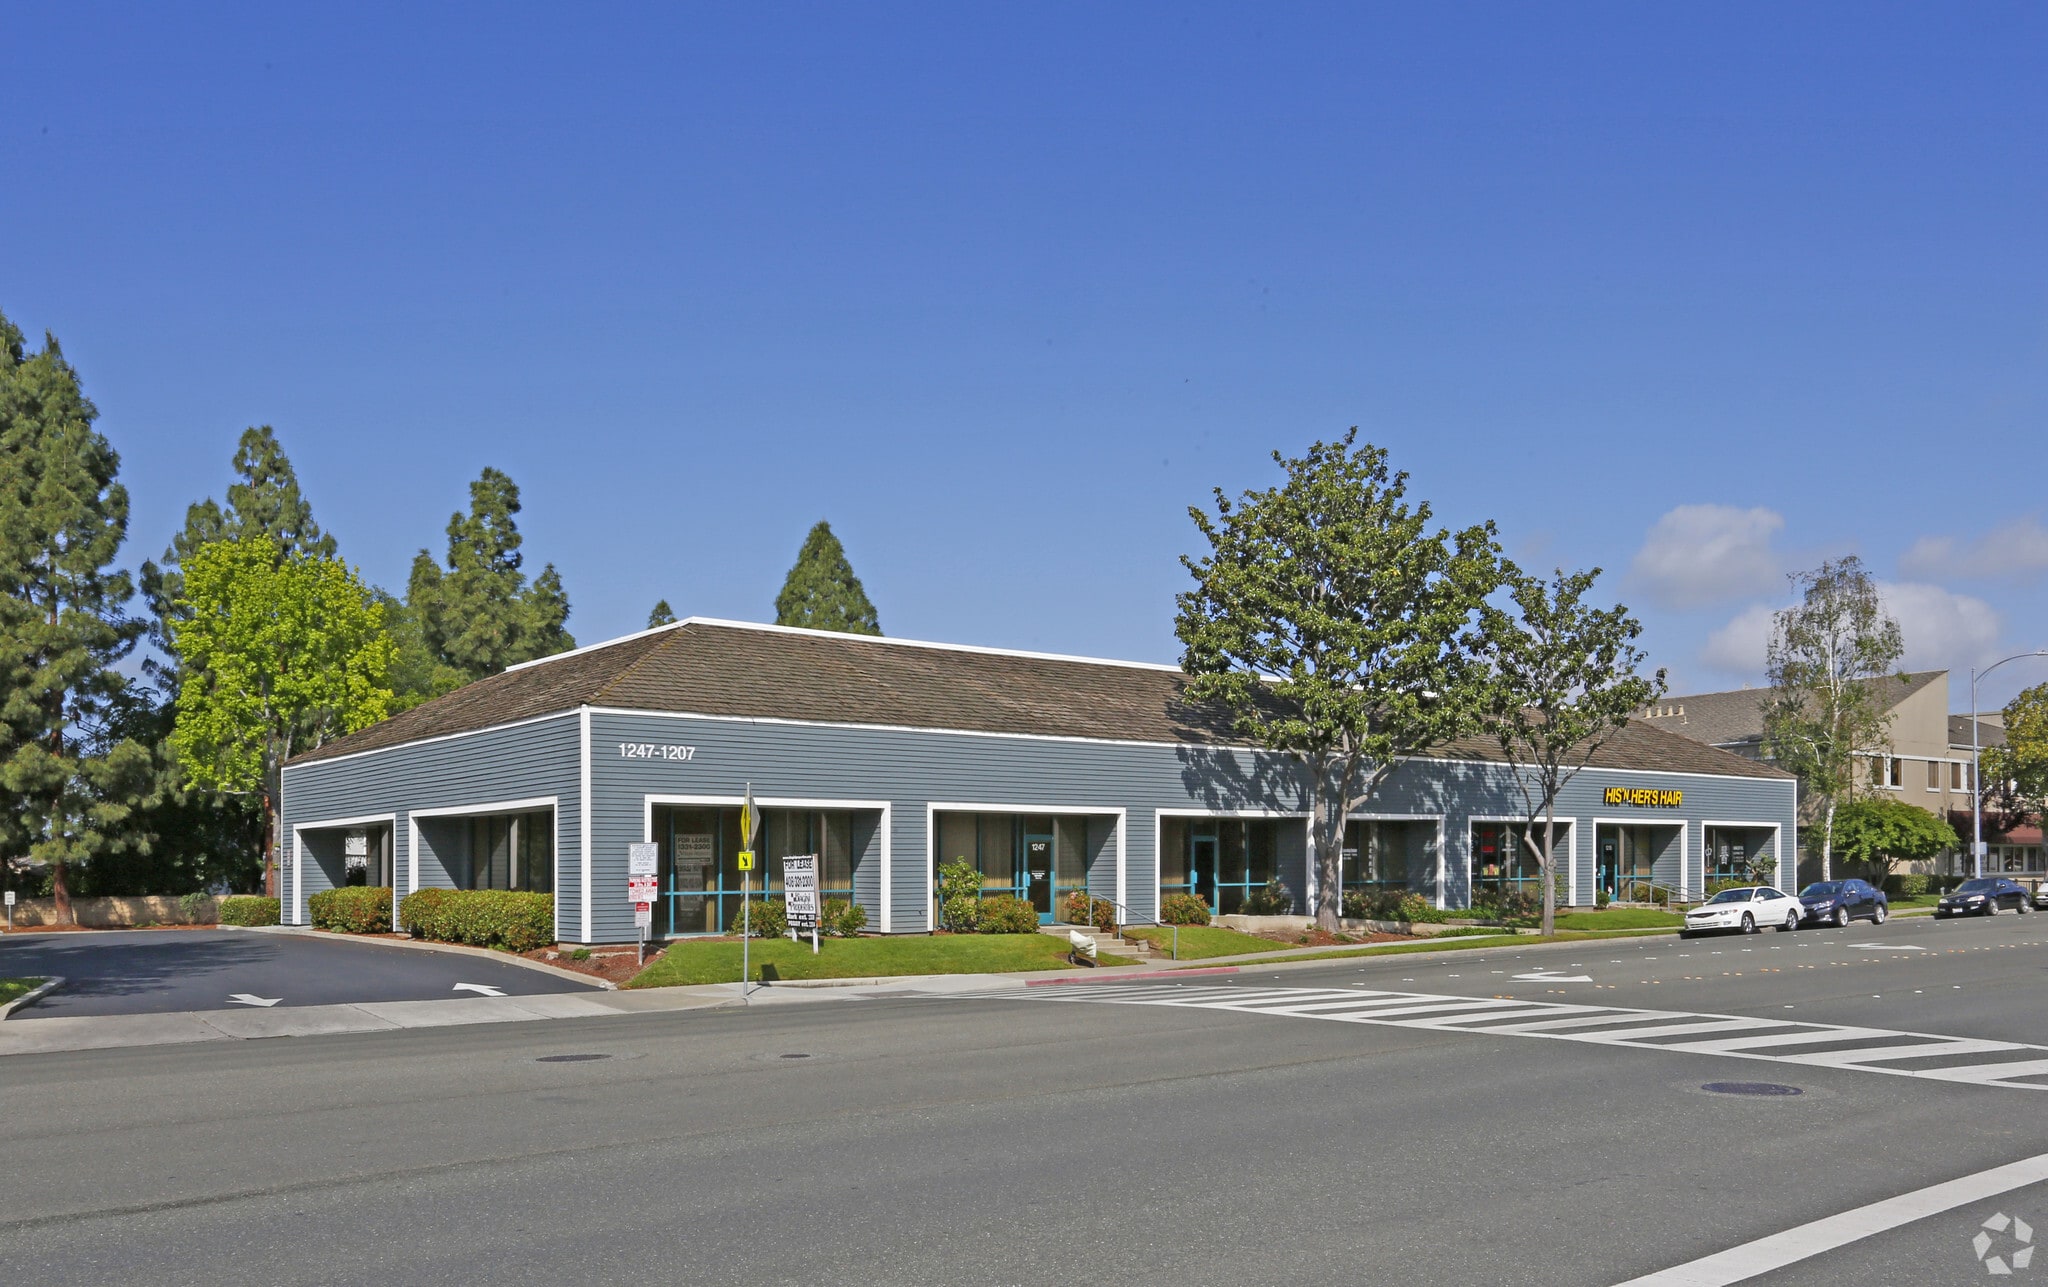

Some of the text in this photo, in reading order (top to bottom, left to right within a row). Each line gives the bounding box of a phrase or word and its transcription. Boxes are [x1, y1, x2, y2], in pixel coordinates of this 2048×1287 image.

[618, 743, 696, 761] 1247-1207
[1631, 789, 1659, 805] HER'S
[1660, 790, 1682, 806] HAIR
[785, 860, 813, 869] FOR LEASE
